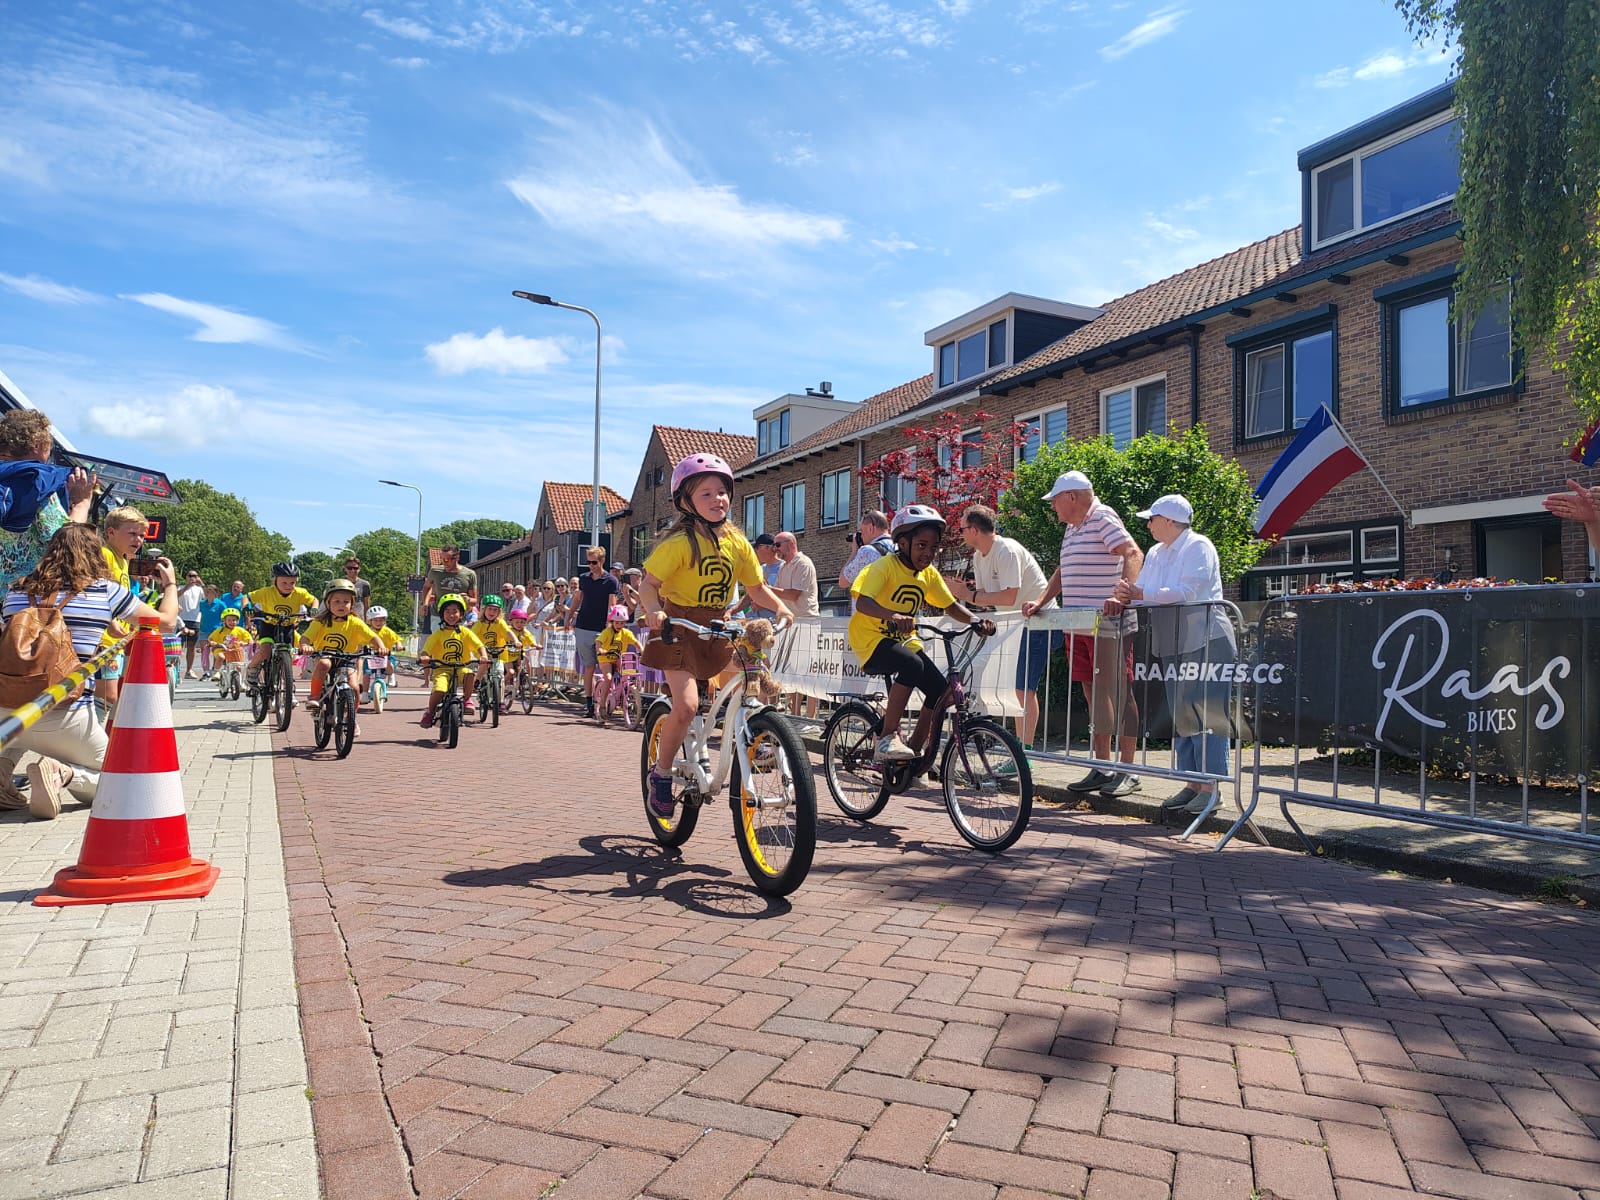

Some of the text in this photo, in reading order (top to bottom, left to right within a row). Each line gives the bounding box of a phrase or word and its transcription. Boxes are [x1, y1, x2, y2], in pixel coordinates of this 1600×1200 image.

[816, 633, 830, 650] En
[1134, 662, 1285, 685] RAASBIKES.CC
[1372, 608, 1571, 742] Raas
